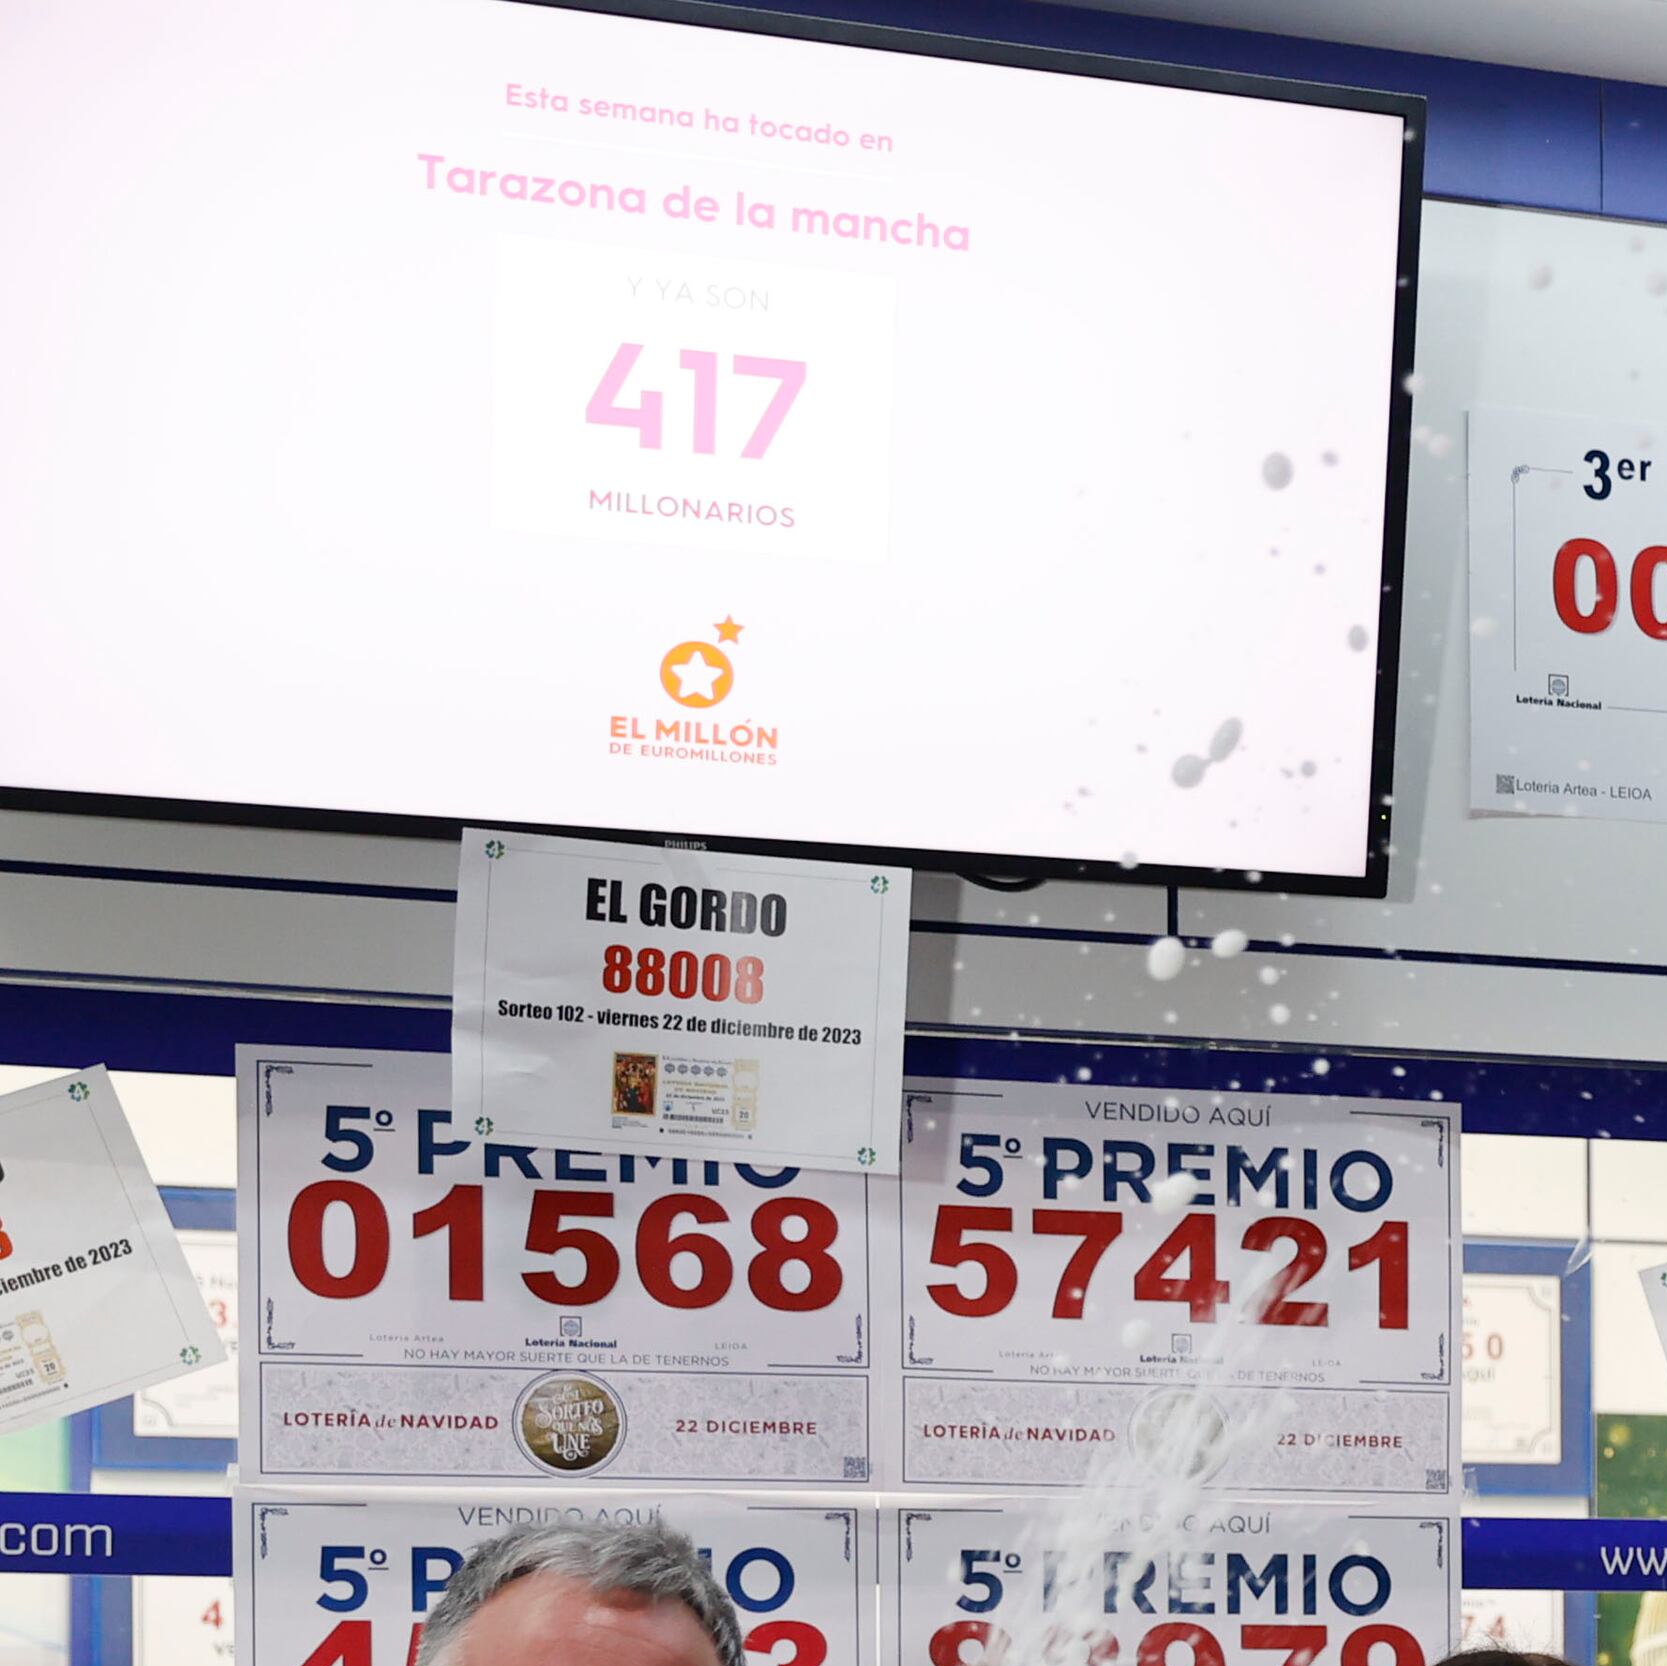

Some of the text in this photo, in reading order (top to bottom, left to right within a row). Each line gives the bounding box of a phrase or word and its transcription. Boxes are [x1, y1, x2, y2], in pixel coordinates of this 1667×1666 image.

[505, 82, 894, 153] Esta semana ha tocado en
[417, 152, 970, 252] Tarazona de la mancha
[585, 342, 808, 461] 417
[1583, 449, 1652, 501] 3er
[588, 489, 796, 529] MILLONARIOS
[1556, 697, 1602, 710] Nacional
[608, 714, 779, 749] EL MILLÓN
[608, 741, 777, 766] DE EUROMILLONES
[1563, 782, 1598, 797] Artea
[1610, 785, 1652, 800] LEIOA
[664, 839, 708, 851] PHILIPS
[585, 877, 787, 938] EL GORDO
[601, 943, 764, 1002] 88008
[497, 999, 862, 1046] Sorteo 102 viernes 22 de diciembre de 2023
[1084, 1099, 1272, 1127] VENDIDO AQUÍ
[321, 1104, 396, 1173] 5º
[956, 1133, 1393, 1214] 5º PREMIO
[65, 1238, 134, 1274] de 2023
[287, 1178, 843, 1313] 01568
[926, 1204, 1409, 1330] 57421
[404, 1348, 730, 1367] NO HAY MAYOR SUERTE QUE LA DE TENERNOS
[568, 1338, 618, 1348] Nacional
[283, 1407, 499, 1431] LOTERÍA de NAVIDAD
[675, 1419, 817, 1435] 22 DICIEMBRE
[923, 1420, 1116, 1443] LOTERÍA de NAVIDAD
[1277, 1432, 1297, 1448] 22
[1210, 1512, 1272, 1536] AQUÍ
[317, 1544, 389, 1613] 5º
[956, 1549, 1023, 1614] 5º
